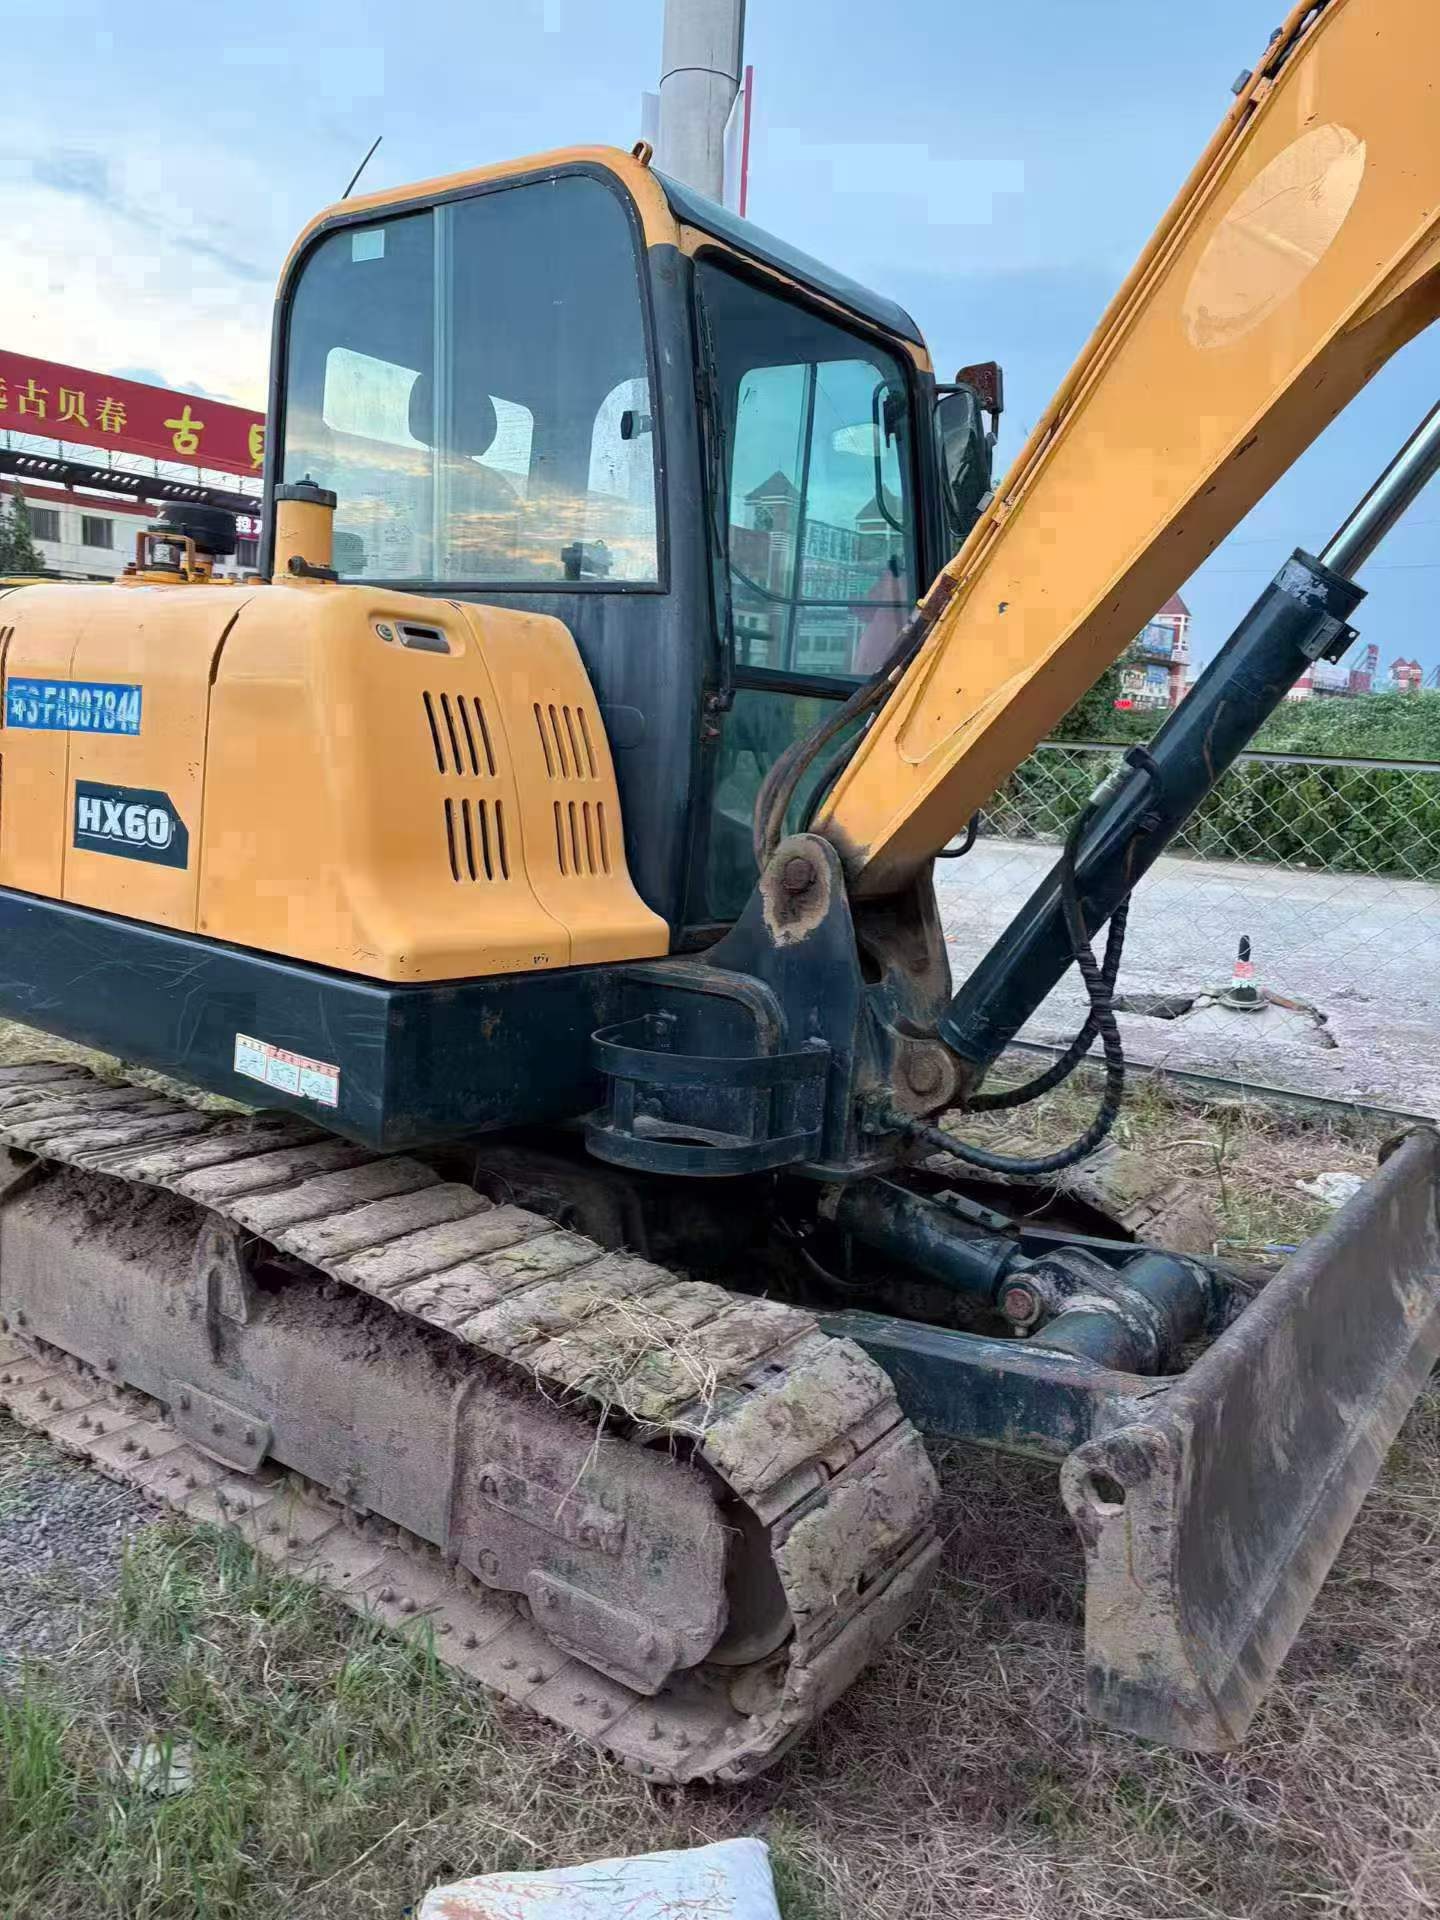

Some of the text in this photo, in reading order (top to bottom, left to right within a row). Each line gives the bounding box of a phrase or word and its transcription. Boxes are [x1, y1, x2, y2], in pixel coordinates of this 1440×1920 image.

[0, 377, 127, 434] 古贝春
[78, 796, 170, 845] HX60
